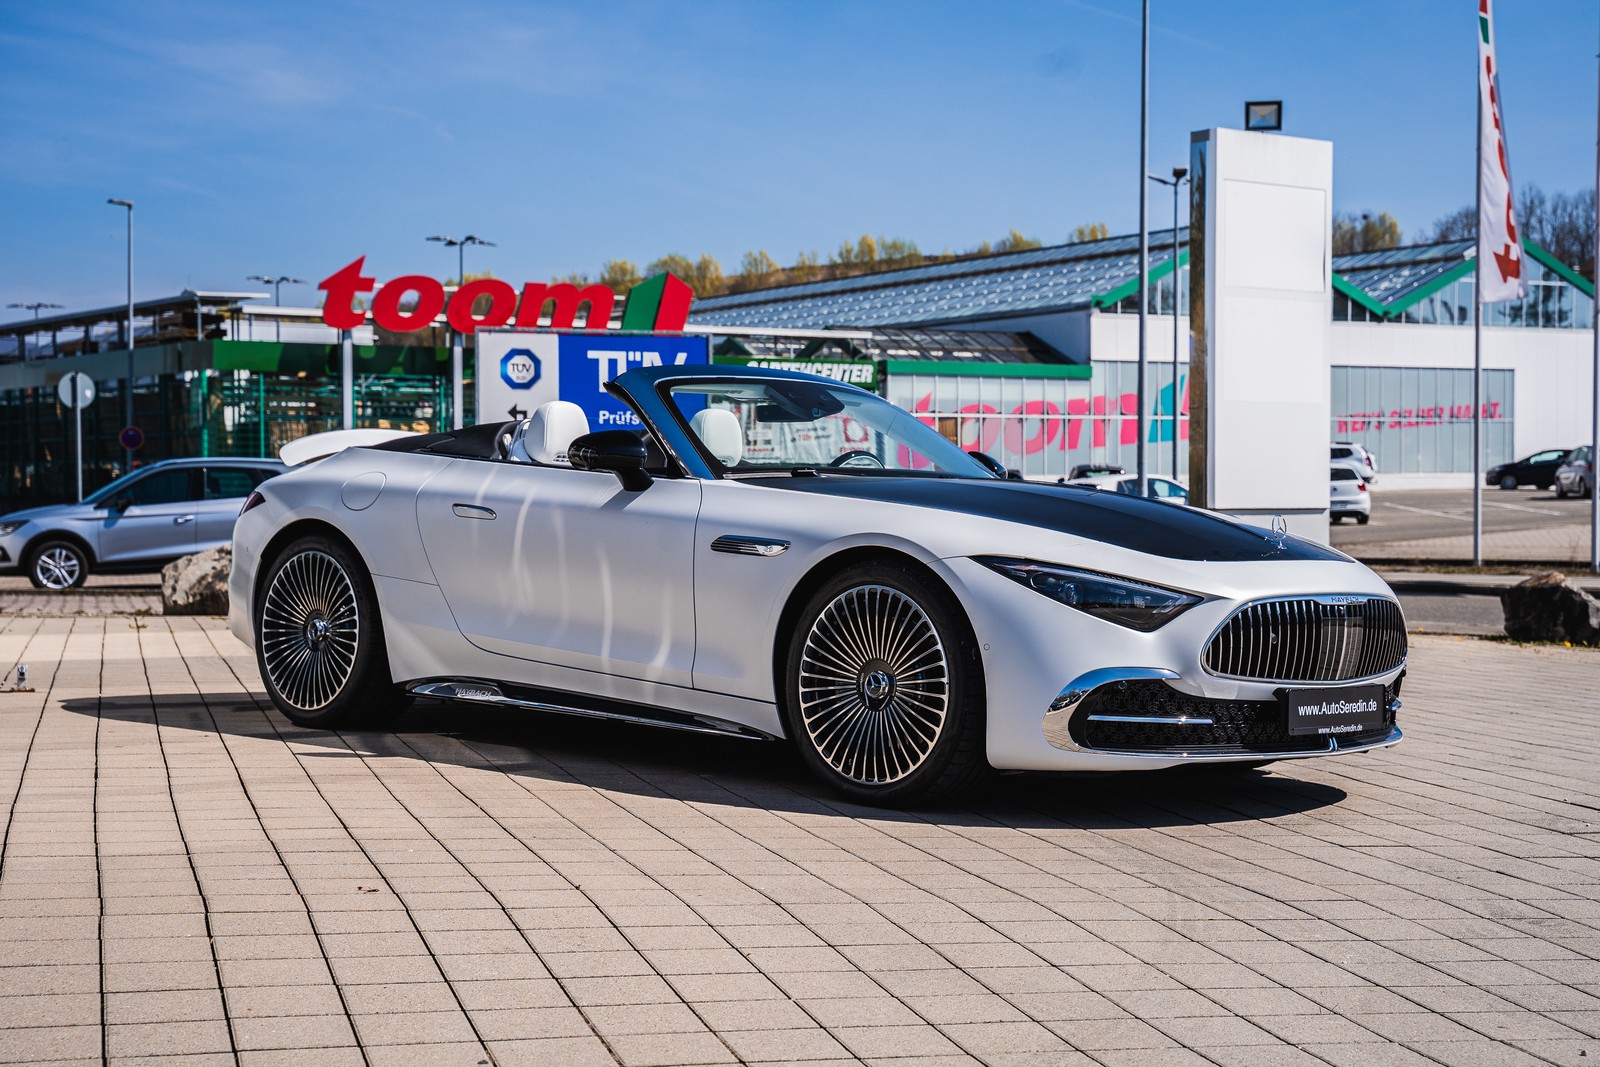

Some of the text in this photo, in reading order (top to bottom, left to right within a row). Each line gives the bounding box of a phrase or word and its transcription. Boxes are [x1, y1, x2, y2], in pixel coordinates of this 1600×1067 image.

[318, 255, 615, 334] toom
[455, 687, 492, 698] MAYBACH
[1298, 699, 1378, 716] www.AutoSeredin.de
[1318, 724, 1363, 734] www.AutoSeredin.de
